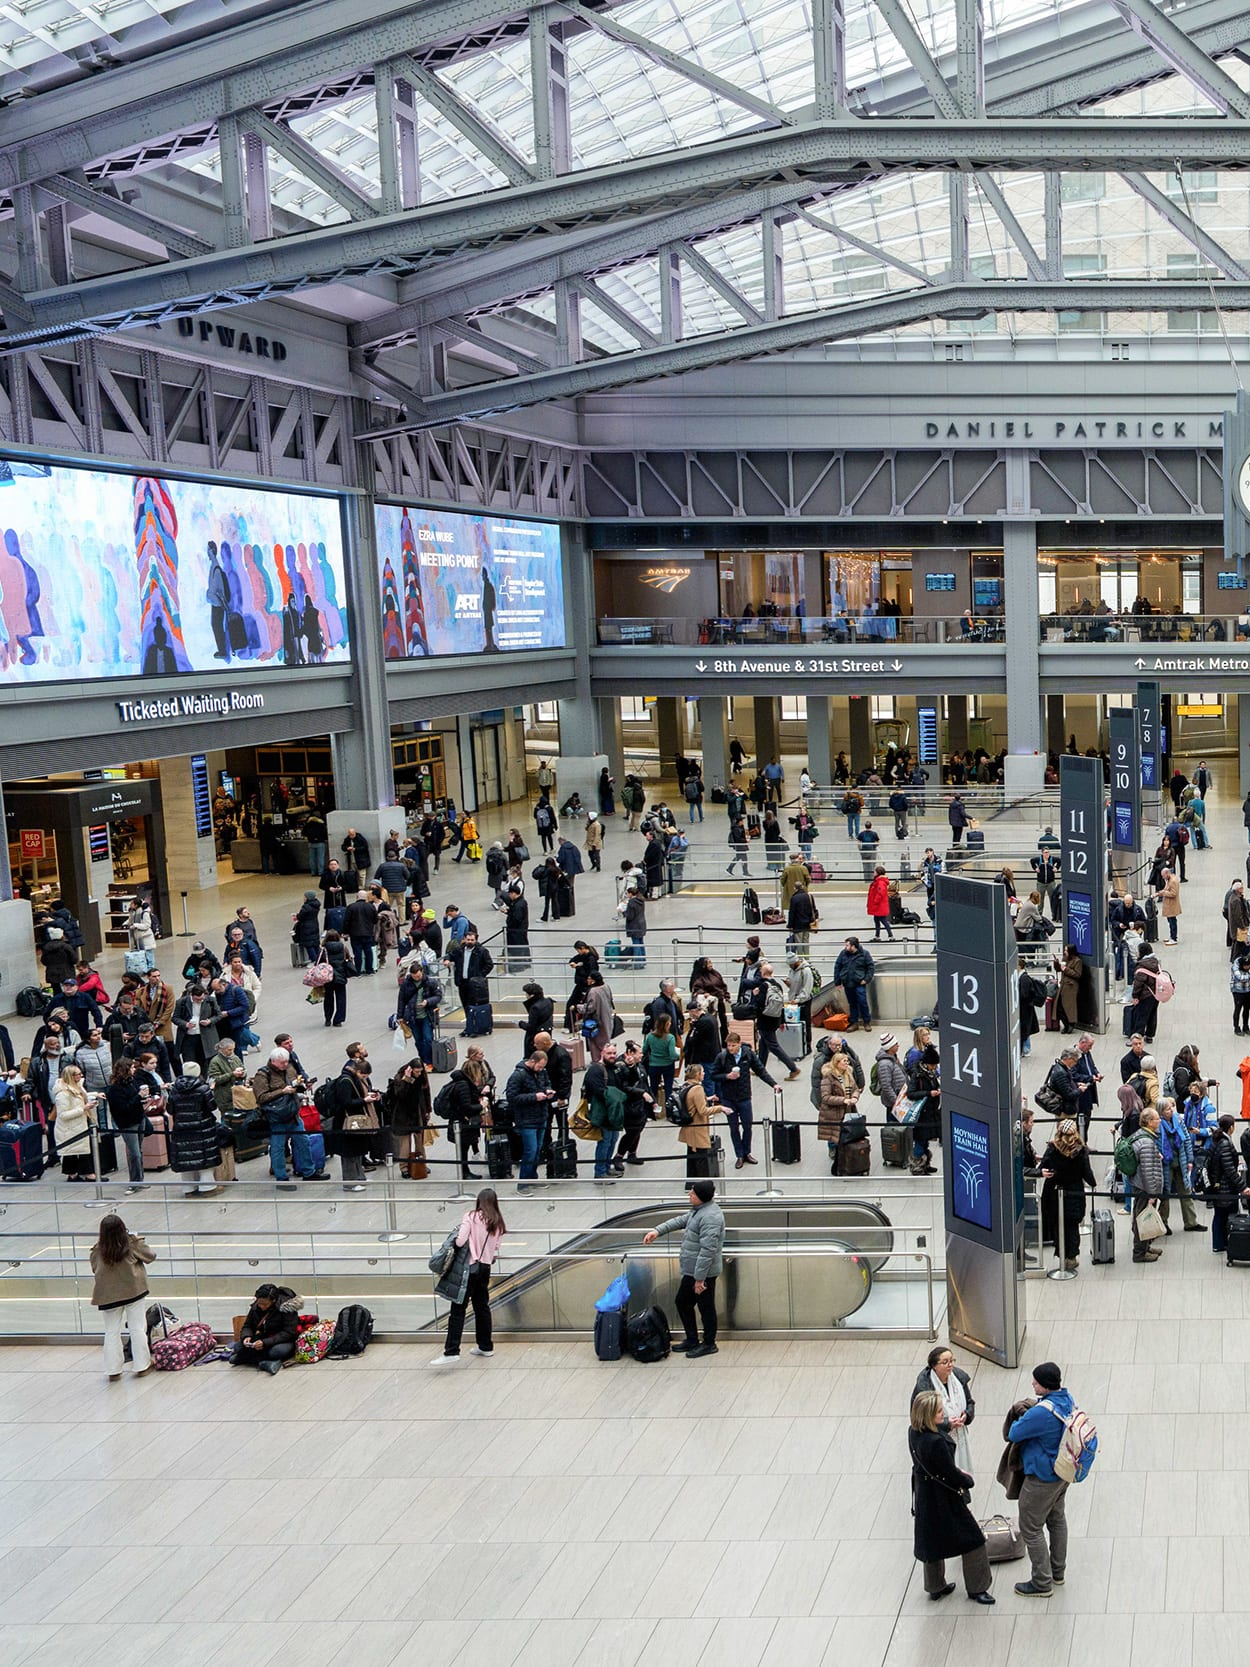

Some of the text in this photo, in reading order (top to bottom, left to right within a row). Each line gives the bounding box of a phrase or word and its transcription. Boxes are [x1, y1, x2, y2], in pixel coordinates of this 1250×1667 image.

[177, 316, 287, 360] UPWARD
[926, 422, 1186, 437] DANIEL PATRICK
[1244, 480, 1250, 488] 9
[418, 529, 435, 541] EZRA
[420, 552, 455, 568] MEETING
[456, 554, 479, 568] POINT
[454, 594, 480, 610] ART
[714, 659, 884, 673] 8th Avenue & 31st Street
[1153, 657, 1205, 670] Amtrak
[119, 691, 264, 722] Ticketed Waiting Room
[1143, 708, 1150, 721] 7
[1143, 730, 1151, 743] 8
[1117, 744, 1127, 760] 9
[1116, 772, 1129, 789] 10
[1069, 809, 1086, 834] 11
[24, 833, 40, 841] RED
[25, 840, 41, 848] CAP
[1068, 850, 1088, 875] 12
[950, 971, 979, 1015] 13
[951, 1042, 983, 1088] 14
[953, 1126, 987, 1144] MOYNIHAN
[953, 1134, 972, 1148] TRAIN
[972, 1141, 989, 1154] HALL
